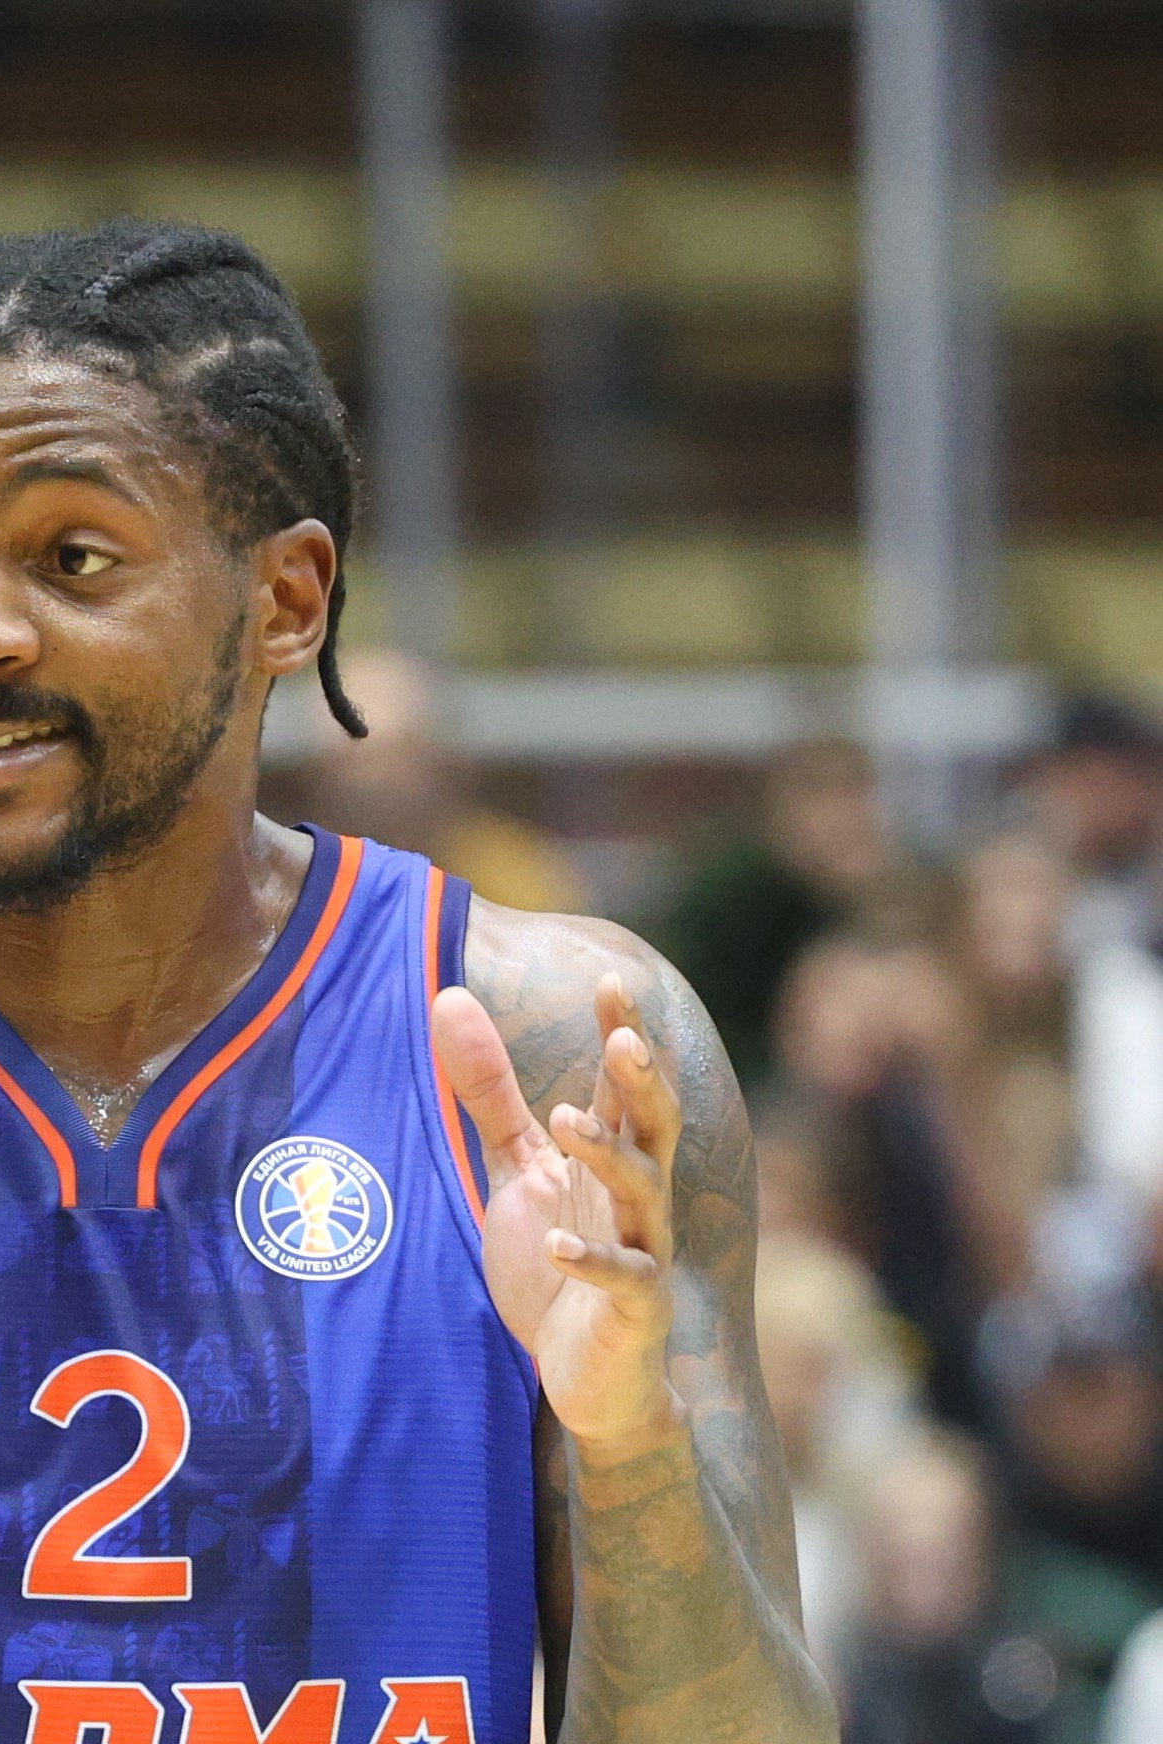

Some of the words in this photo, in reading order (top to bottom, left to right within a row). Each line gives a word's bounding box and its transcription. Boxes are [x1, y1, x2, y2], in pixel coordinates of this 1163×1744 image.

[252, 1144, 307, 1183] ЕДИНАЯ
[310, 1144, 348, 1166] ЛИГА
[349, 1161, 373, 1185] ВТБ
[257, 1235, 278, 1259] VTB
[279, 1255, 332, 1272] UNITED
[334, 1235, 377, 1271] LEAGUE
[22, 1348, 192, 1602] 2
